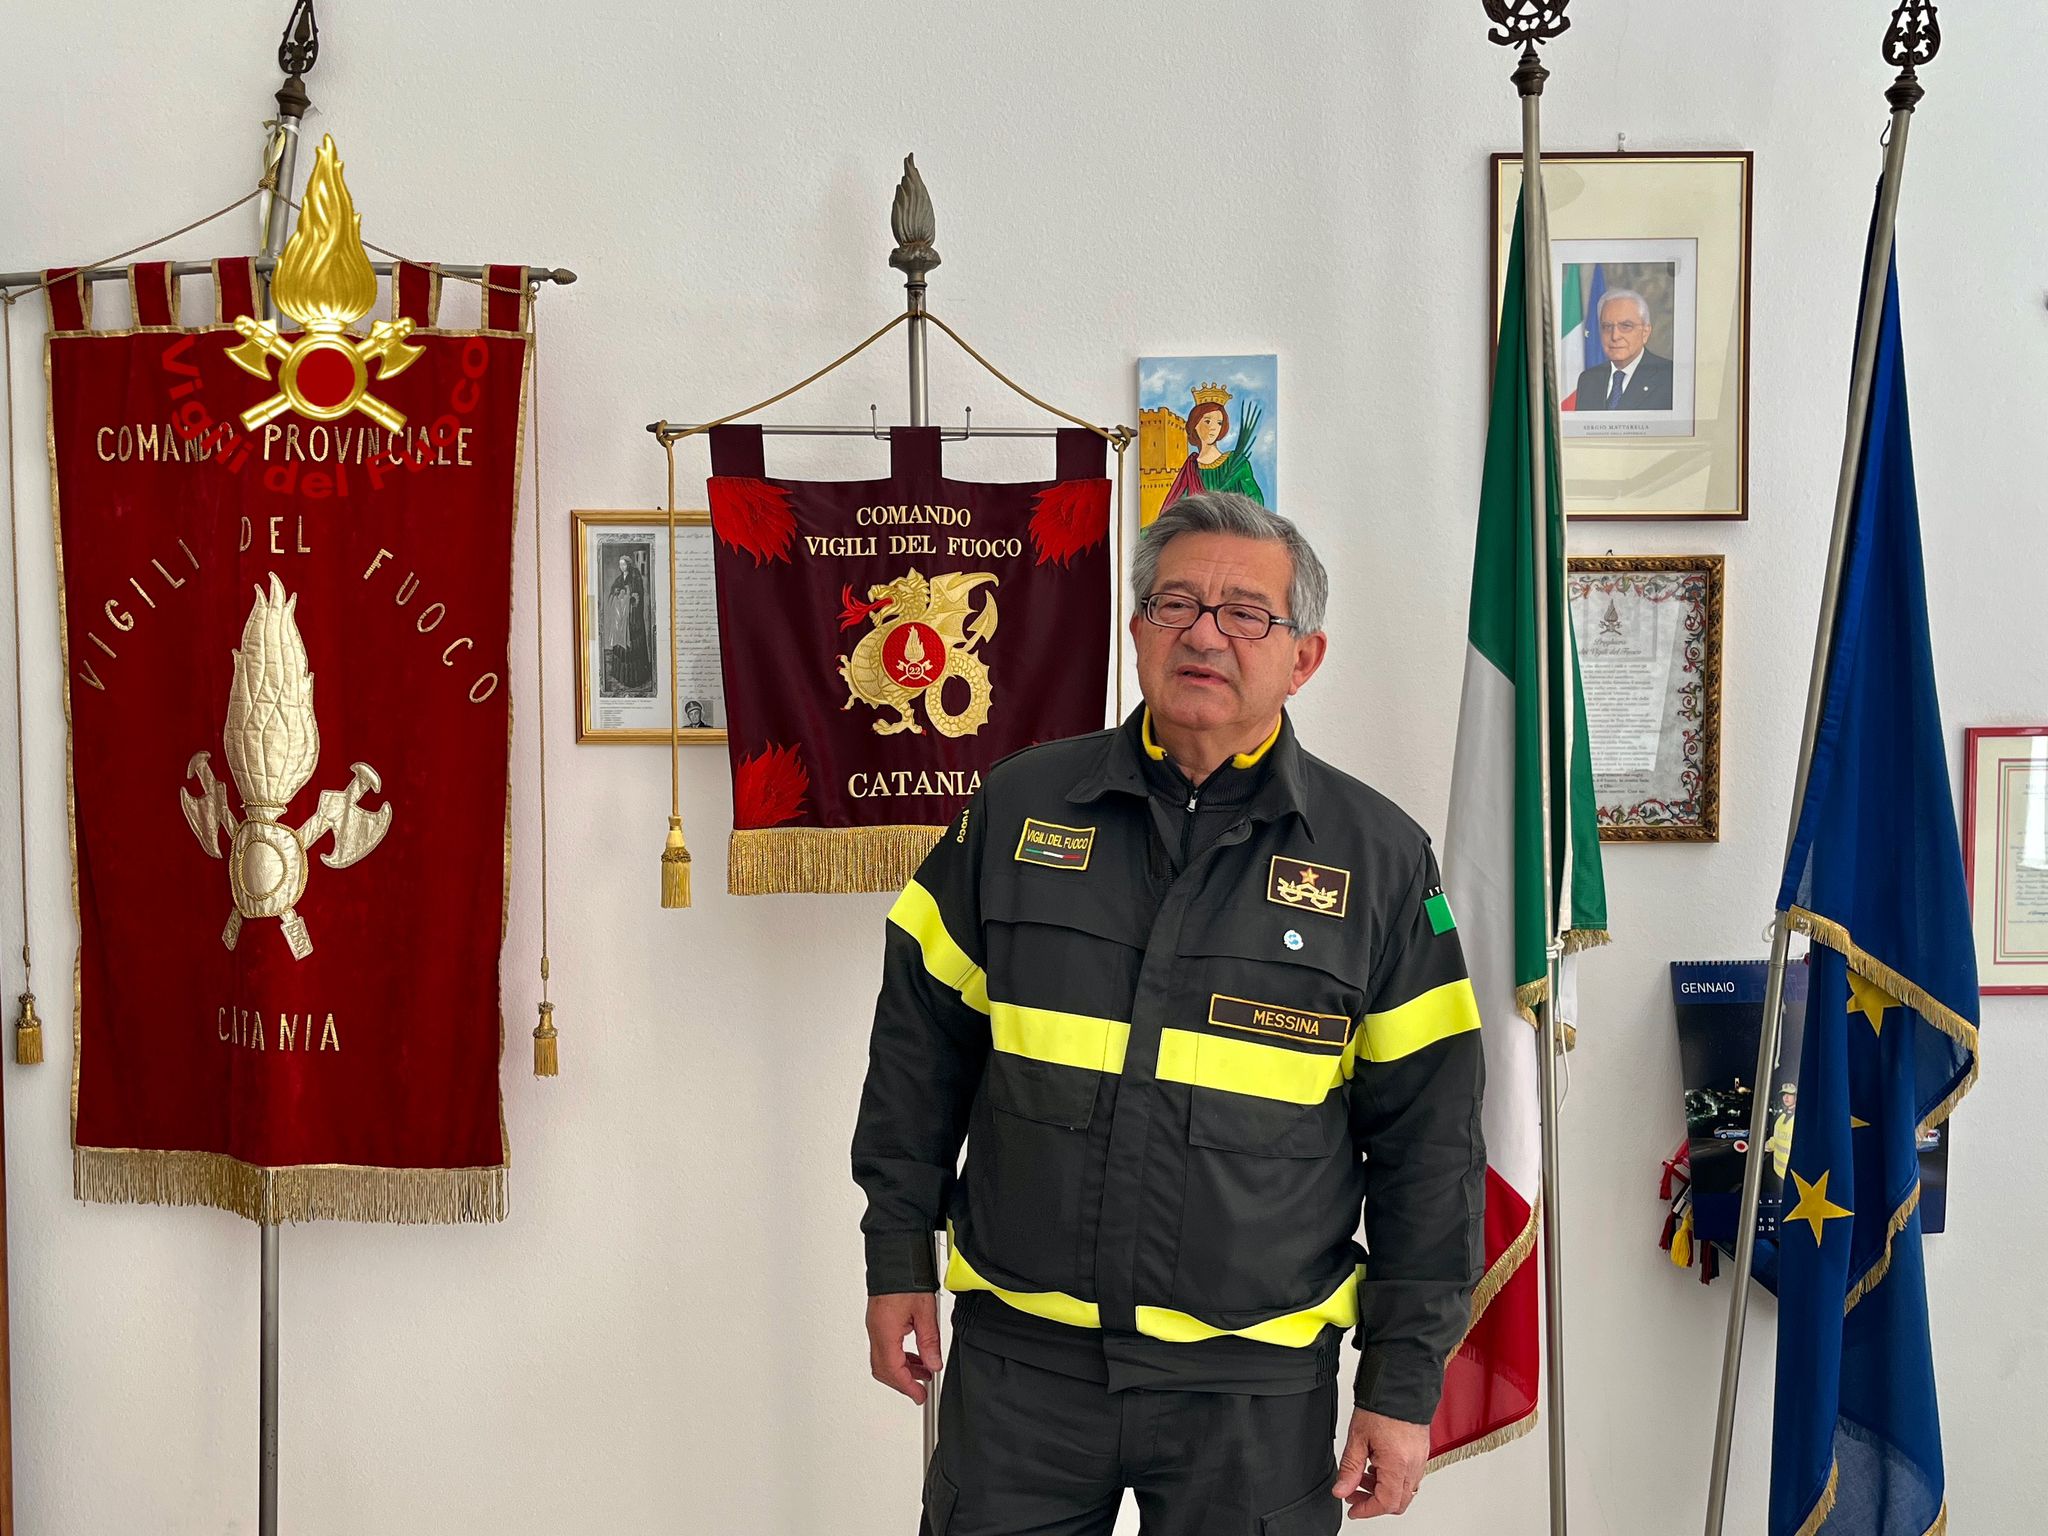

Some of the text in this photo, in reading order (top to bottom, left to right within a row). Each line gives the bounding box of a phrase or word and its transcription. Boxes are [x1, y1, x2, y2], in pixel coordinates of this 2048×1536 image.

[263, 424, 473, 466] PROVINCIALE
[855, 505, 972, 528] COMANDO
[804, 535, 1023, 558] VIGILI DEL FUOCO
[78, 539, 200, 691] VIGILI
[239, 515, 311, 554] DEL
[363, 548, 499, 704] FUOCO
[909, 666, 921, 675] 22
[847, 769, 982, 799] CATANIA
[1026, 828, 1089, 850] VIGILI DEL FUOCO
[1680, 981, 1735, 994] GENNAIO
[1252, 1009, 1320, 1036] MESSINA
